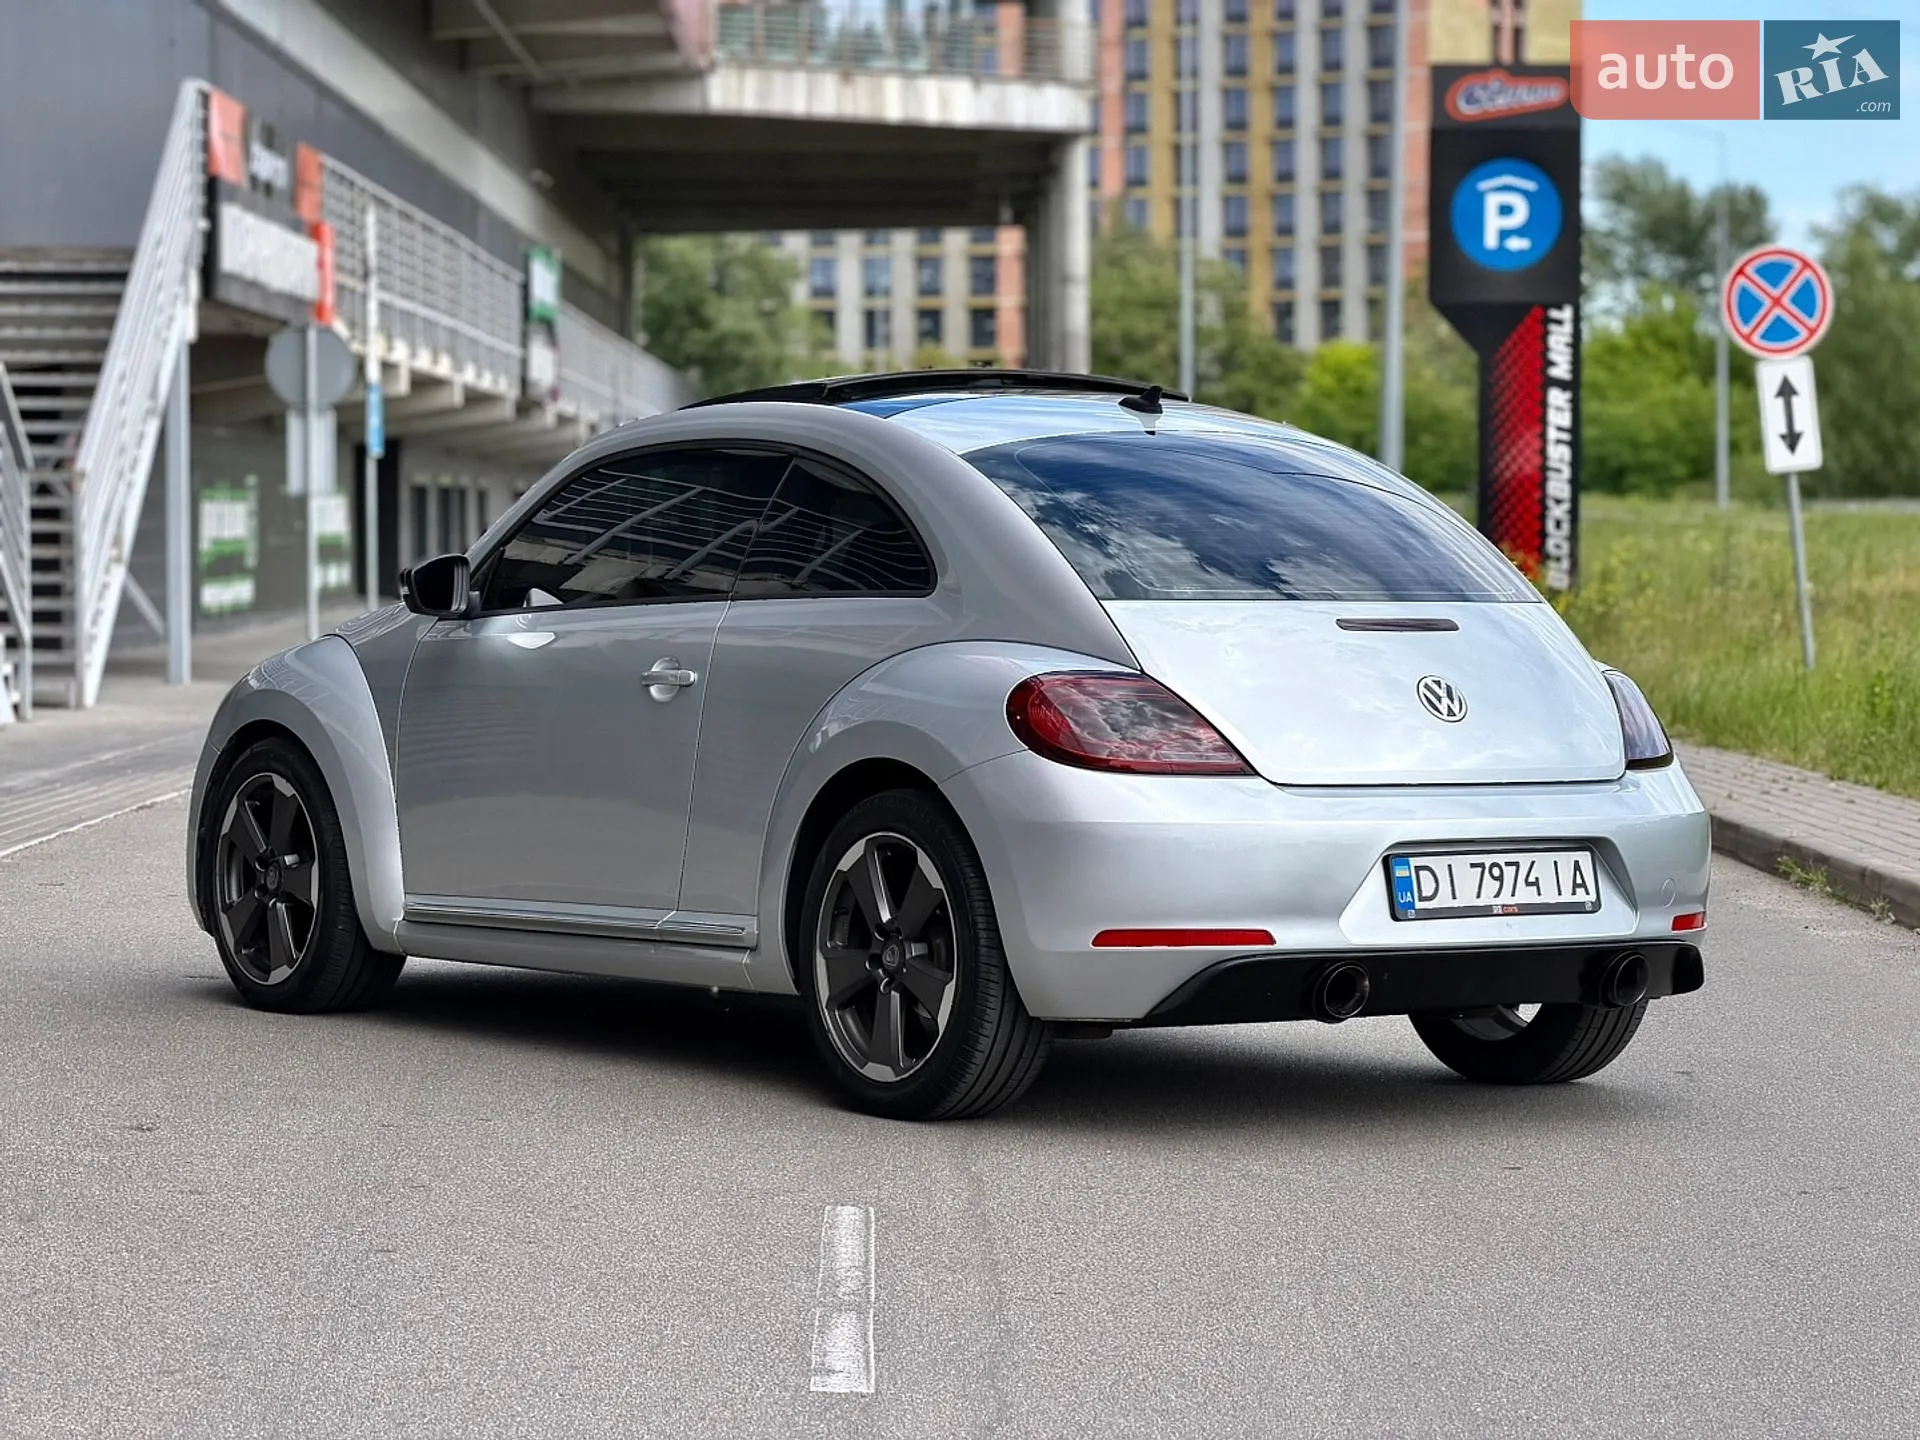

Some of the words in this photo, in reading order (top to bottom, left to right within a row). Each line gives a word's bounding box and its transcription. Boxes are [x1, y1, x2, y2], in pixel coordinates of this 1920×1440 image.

[1483, 191, 1530, 251] P
[1546, 303, 1574, 381] MALL
[1545, 386, 1572, 590] BLOCKBUSTER
[1398, 891, 1414, 904] UA
[1413, 863, 1457, 903] DI
[1469, 860, 1542, 899] 7974
[1552, 859, 1591, 897] IA
